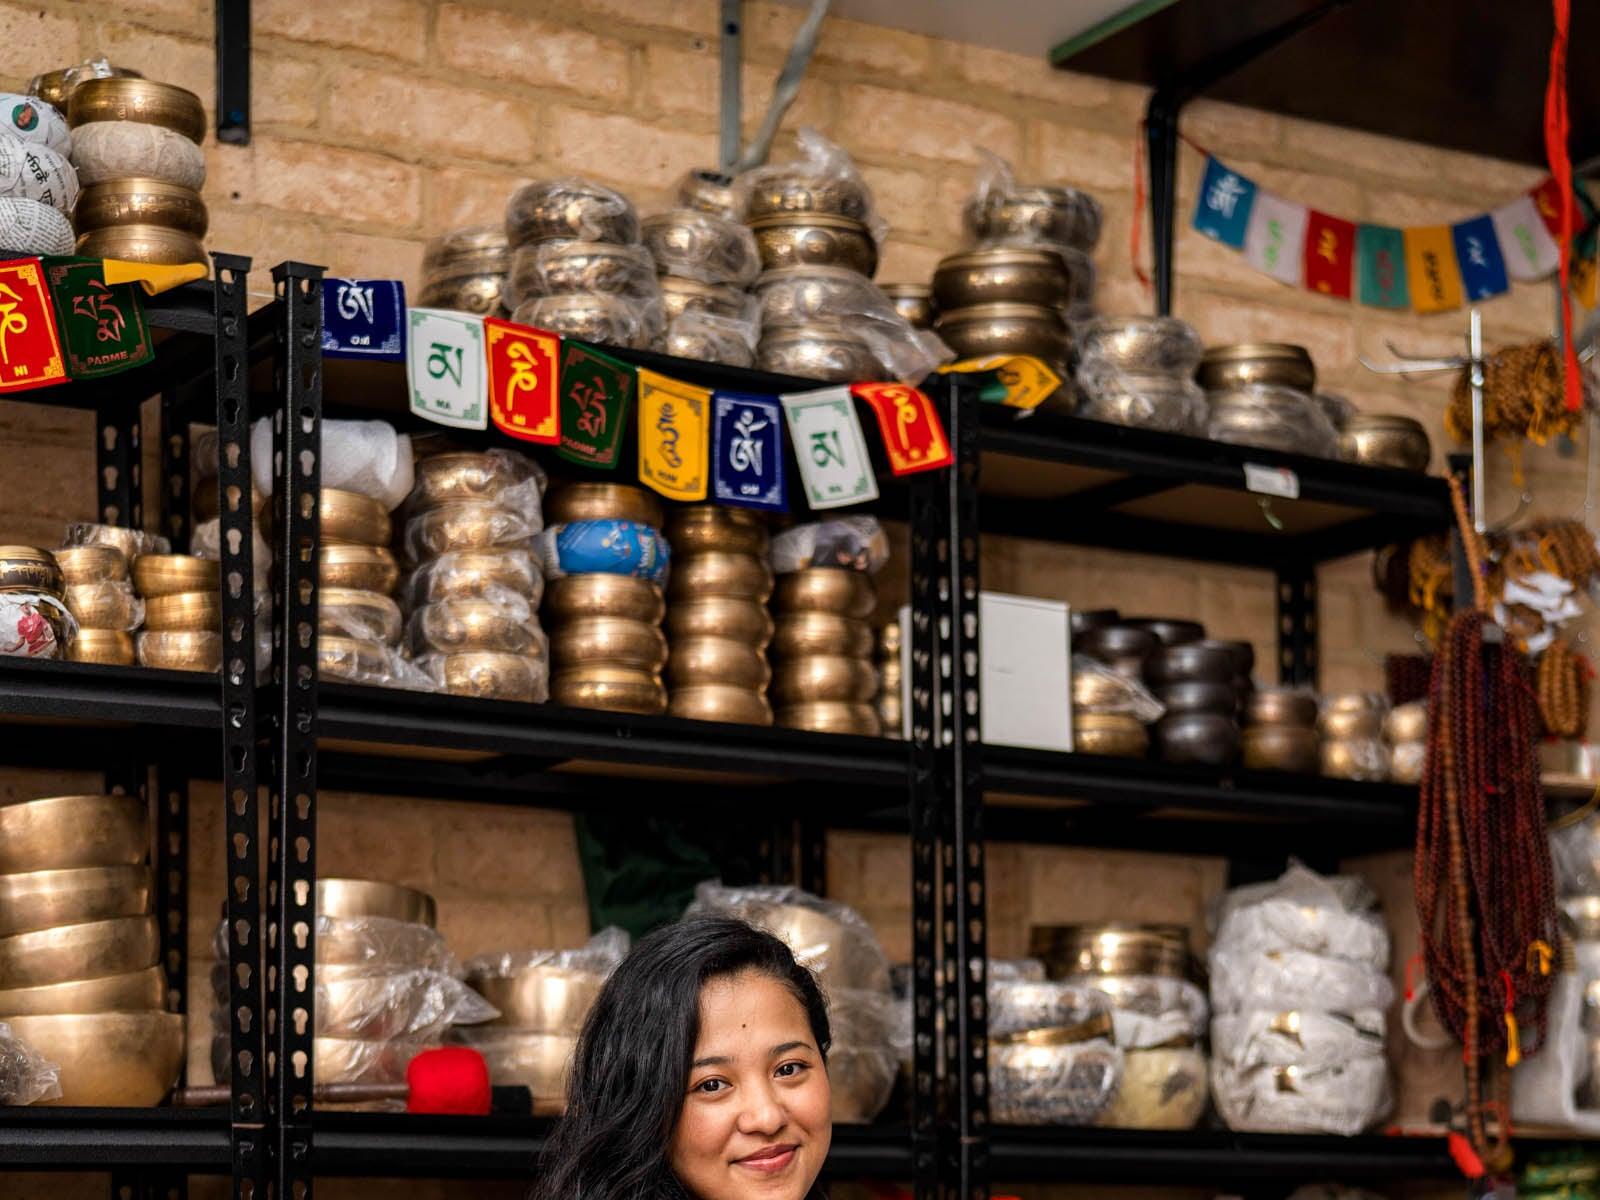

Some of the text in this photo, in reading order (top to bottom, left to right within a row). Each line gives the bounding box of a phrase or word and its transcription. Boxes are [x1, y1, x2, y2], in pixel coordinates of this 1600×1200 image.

[350, 335, 370, 346] OM
[87, 350, 129, 366] PADME
[13, 364, 29, 377] NI
